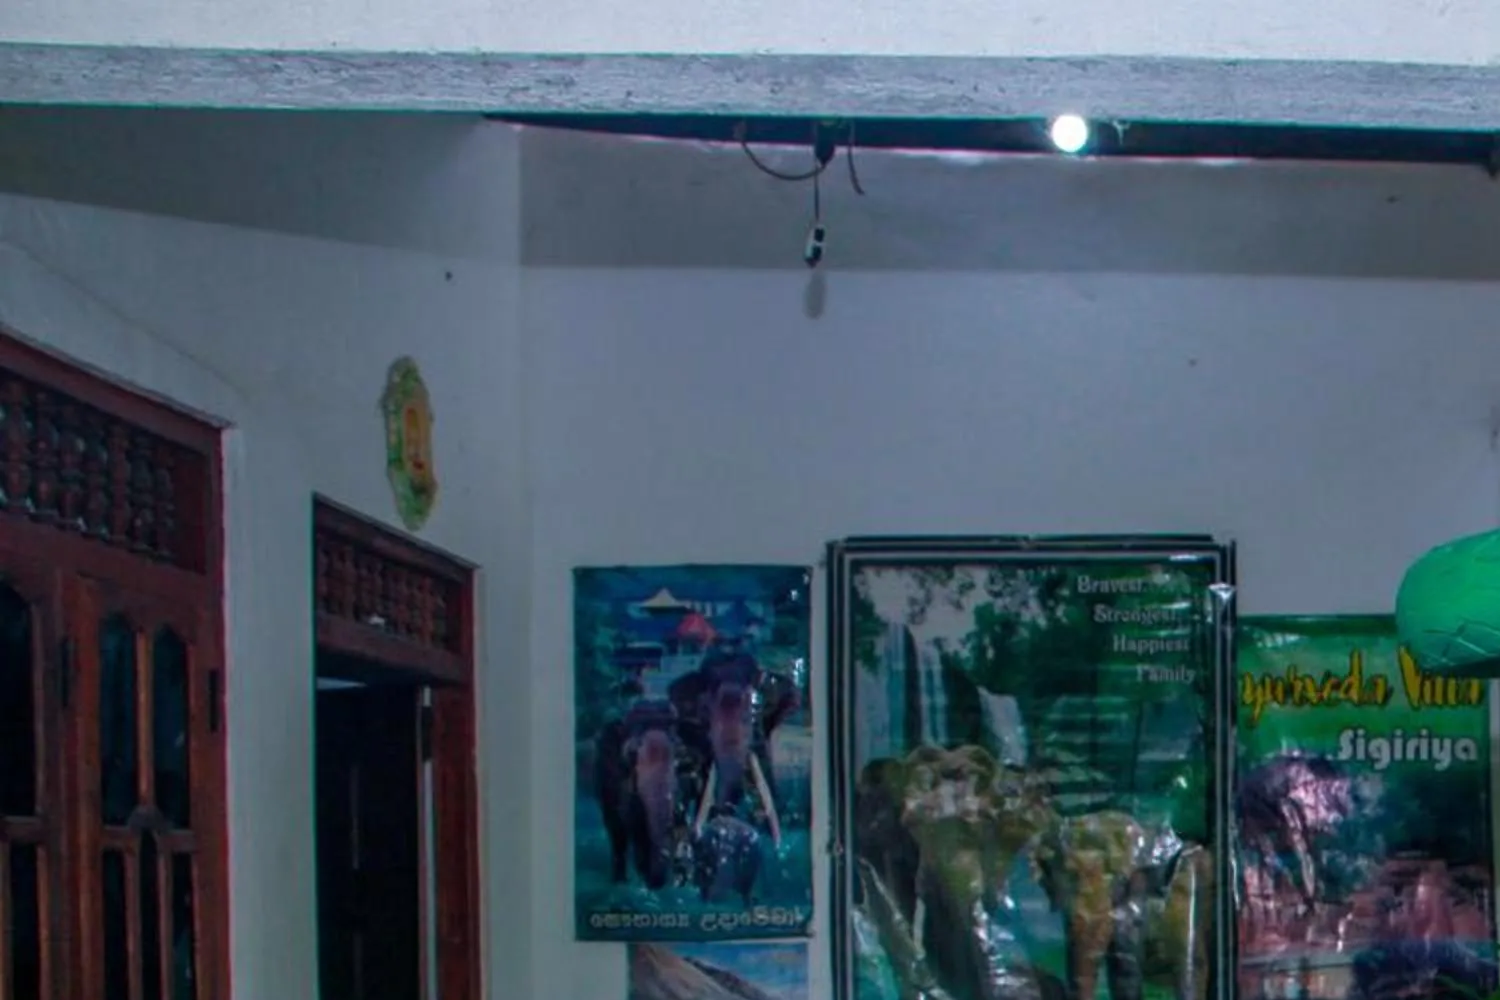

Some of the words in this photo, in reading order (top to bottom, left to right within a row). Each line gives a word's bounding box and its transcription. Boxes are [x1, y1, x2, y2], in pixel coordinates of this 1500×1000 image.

[1112, 633, 1190, 656] Happiest
[1136, 663, 1196, 685] Family
[1337, 728, 1479, 772] Sigiriya
